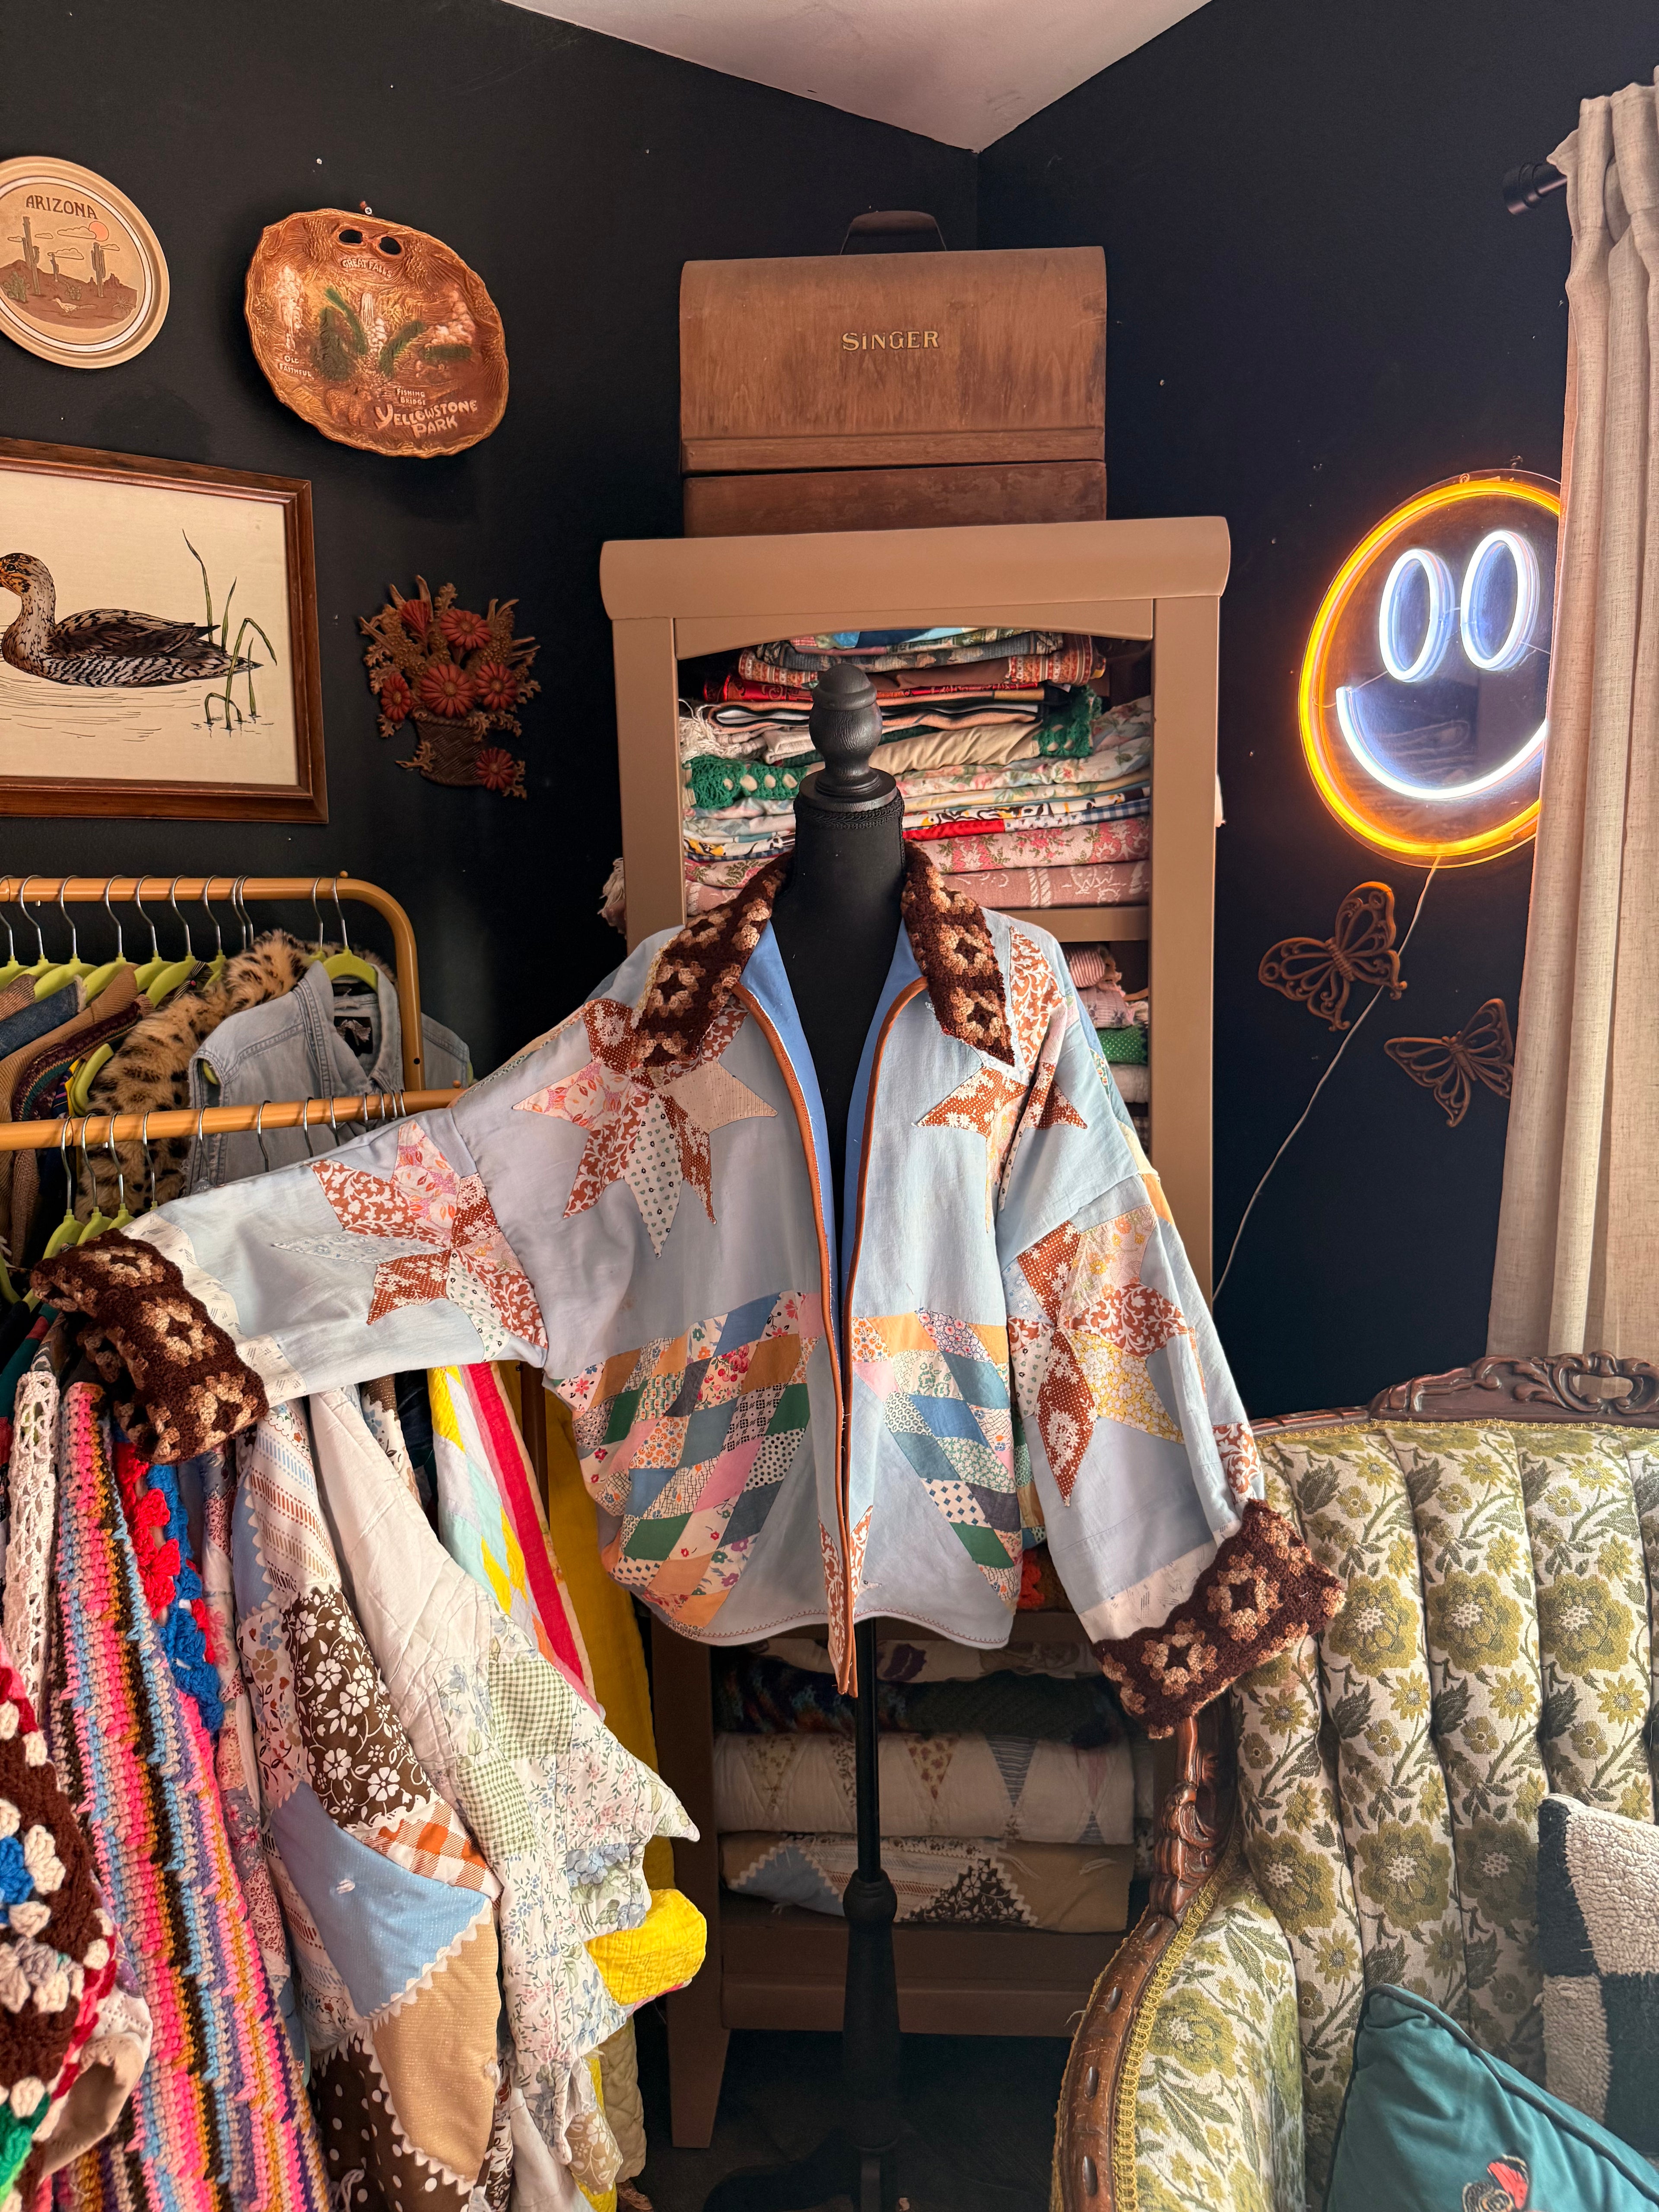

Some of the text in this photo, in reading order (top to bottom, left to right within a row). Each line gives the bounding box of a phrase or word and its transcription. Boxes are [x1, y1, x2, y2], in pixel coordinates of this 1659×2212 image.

[26, 195, 99, 219] ARIZONA
[342, 258, 392, 278] GREAT FALLS
[842, 331, 940, 351] SINGER
[397, 388, 425, 397] FISHING
[400, 397, 426, 406] BRIDGE
[375, 400, 477, 430] YELLOWSTONE
[412, 415, 458, 438] PARK
